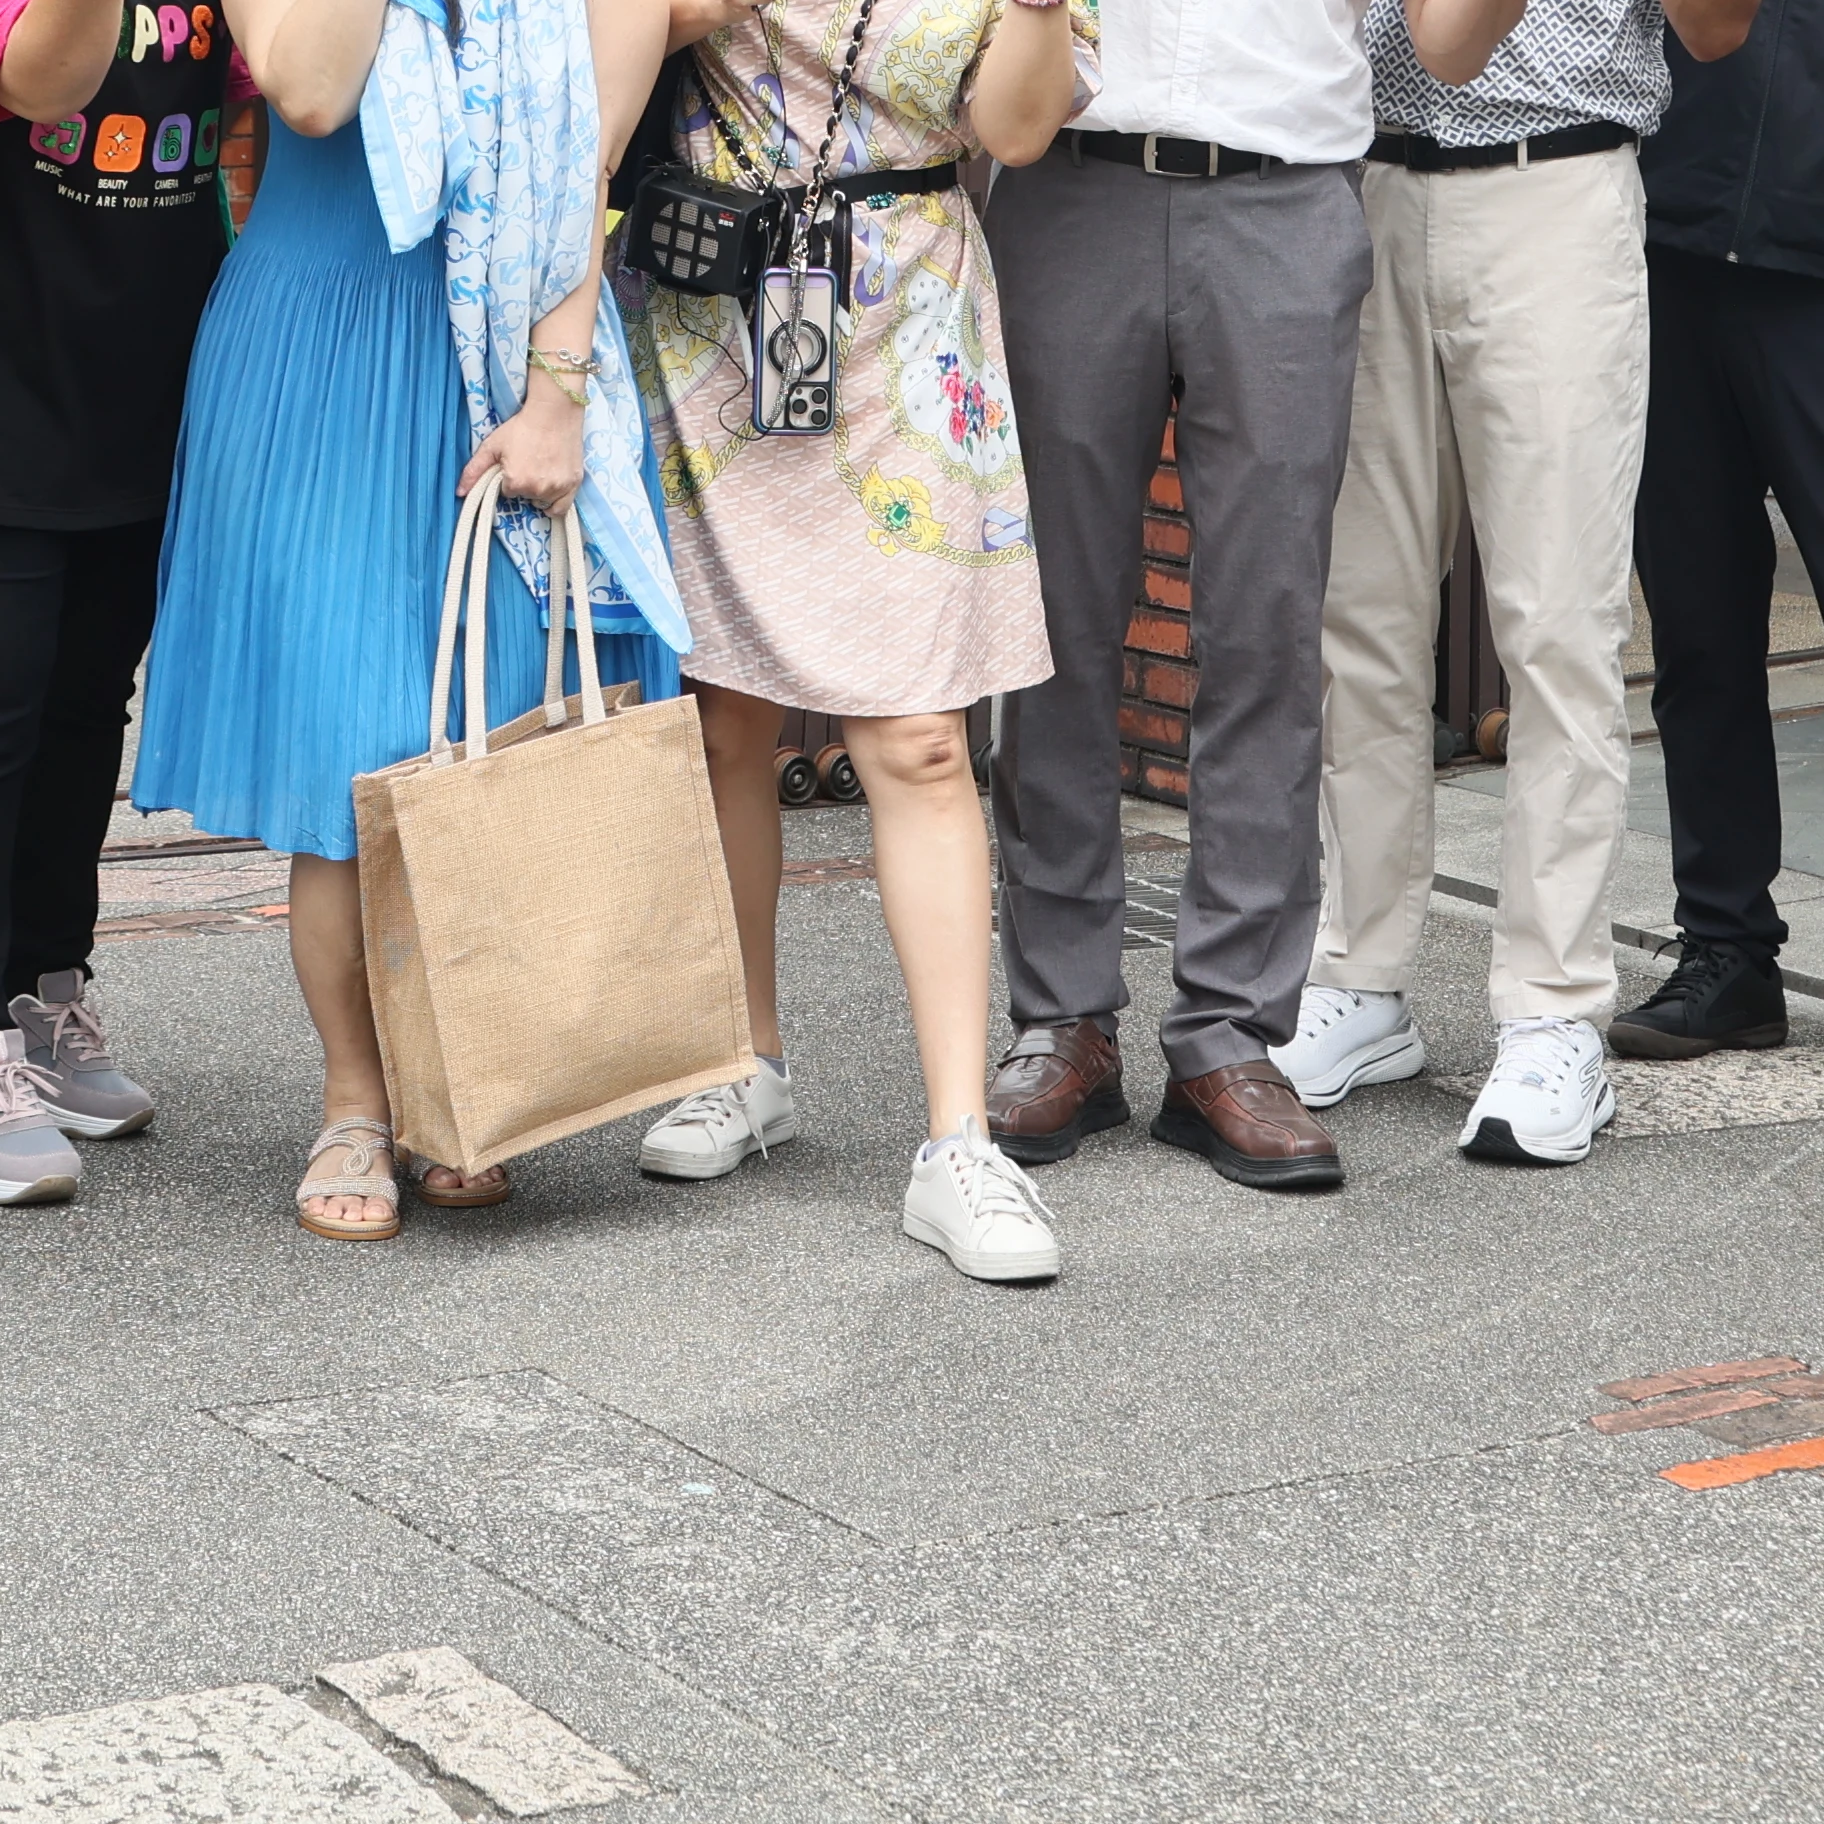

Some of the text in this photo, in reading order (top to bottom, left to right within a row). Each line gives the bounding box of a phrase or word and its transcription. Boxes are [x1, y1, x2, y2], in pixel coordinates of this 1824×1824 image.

[35, 160, 64, 177] MUSIC
[98, 179, 128, 190] BEAUTY
[154, 179, 178, 190] CAMERA
[57, 184, 196, 208] WHAT ARE YOUR FAVORITES?
